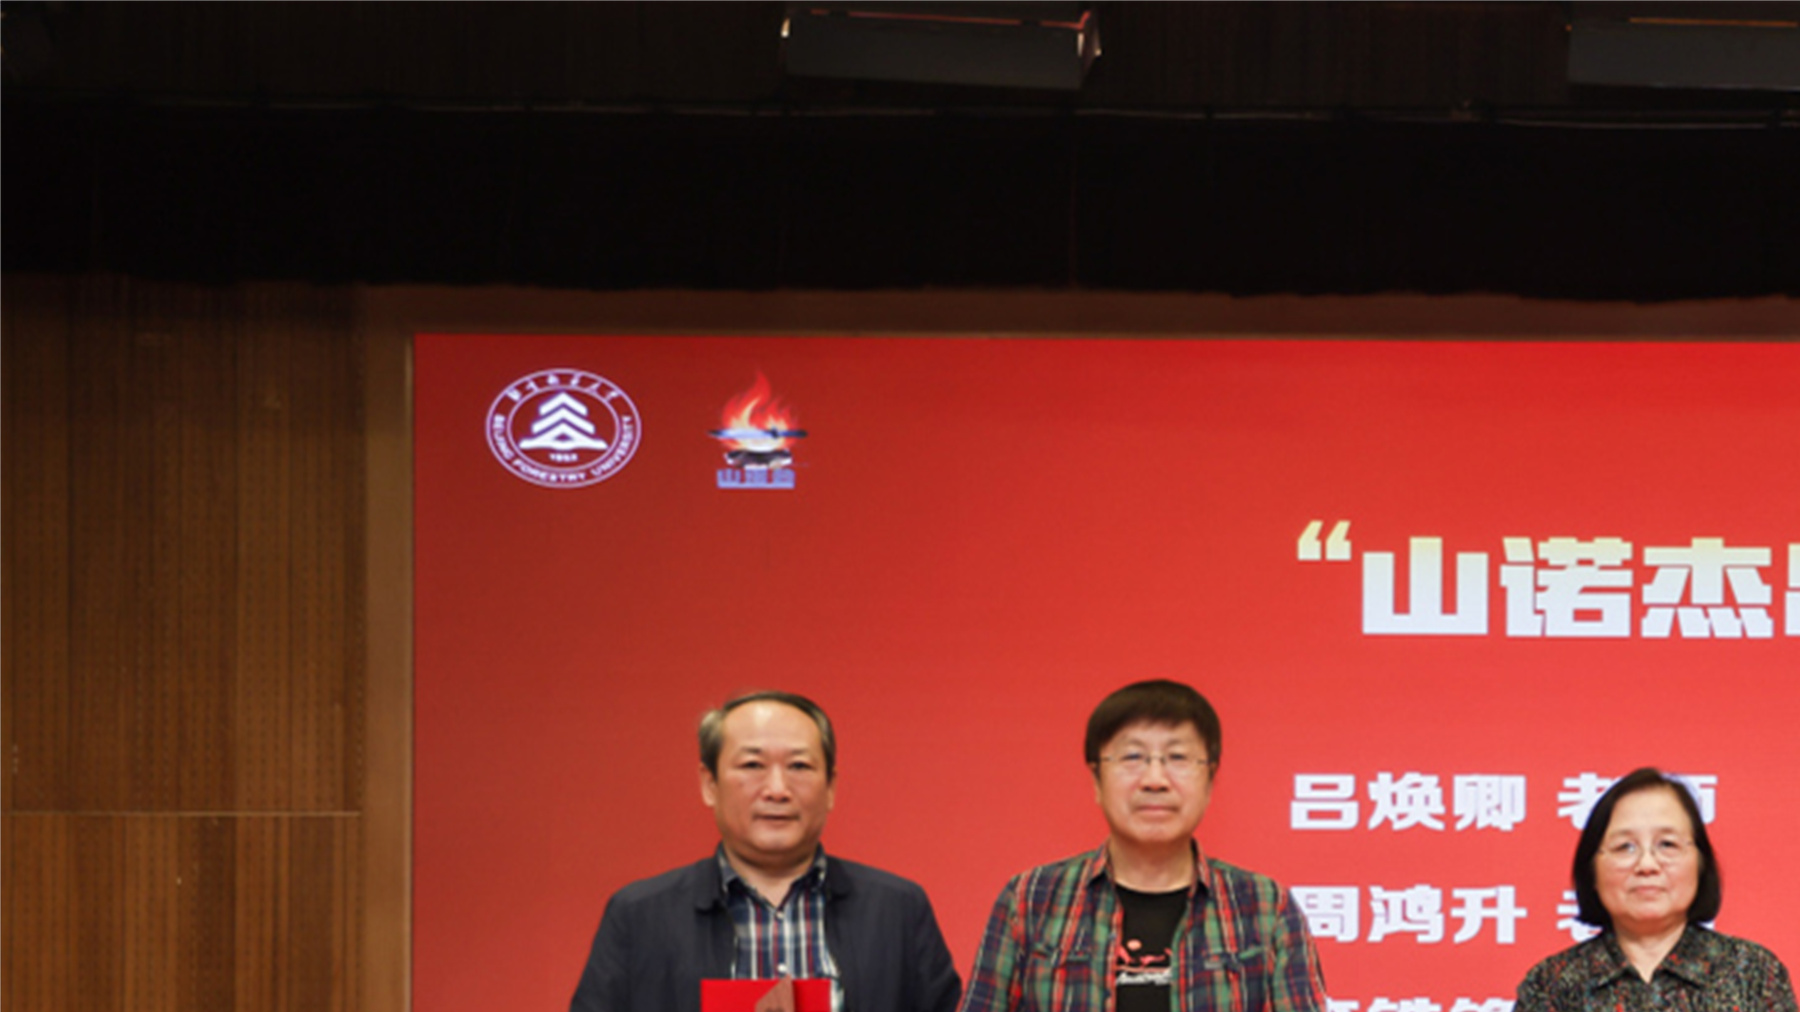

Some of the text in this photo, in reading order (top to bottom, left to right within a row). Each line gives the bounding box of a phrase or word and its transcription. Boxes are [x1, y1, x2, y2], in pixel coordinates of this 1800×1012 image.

[1289, 771, 1527, 832] 吕焕卿
[1289, 884, 1528, 944] 周鸿升
